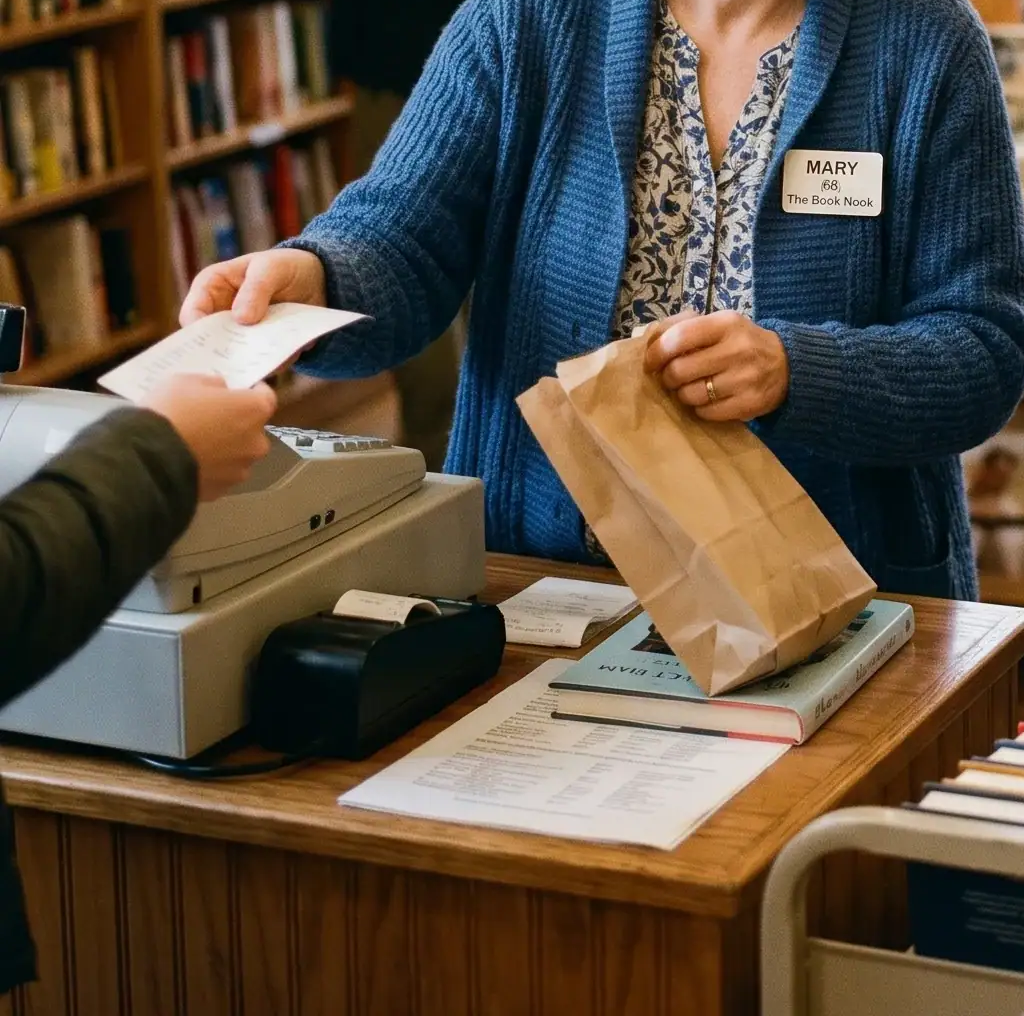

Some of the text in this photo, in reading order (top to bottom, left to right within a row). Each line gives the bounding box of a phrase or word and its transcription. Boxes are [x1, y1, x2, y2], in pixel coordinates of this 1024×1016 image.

[806, 160, 859, 176] MARY
[787, 194, 874, 208] The Book Nook
